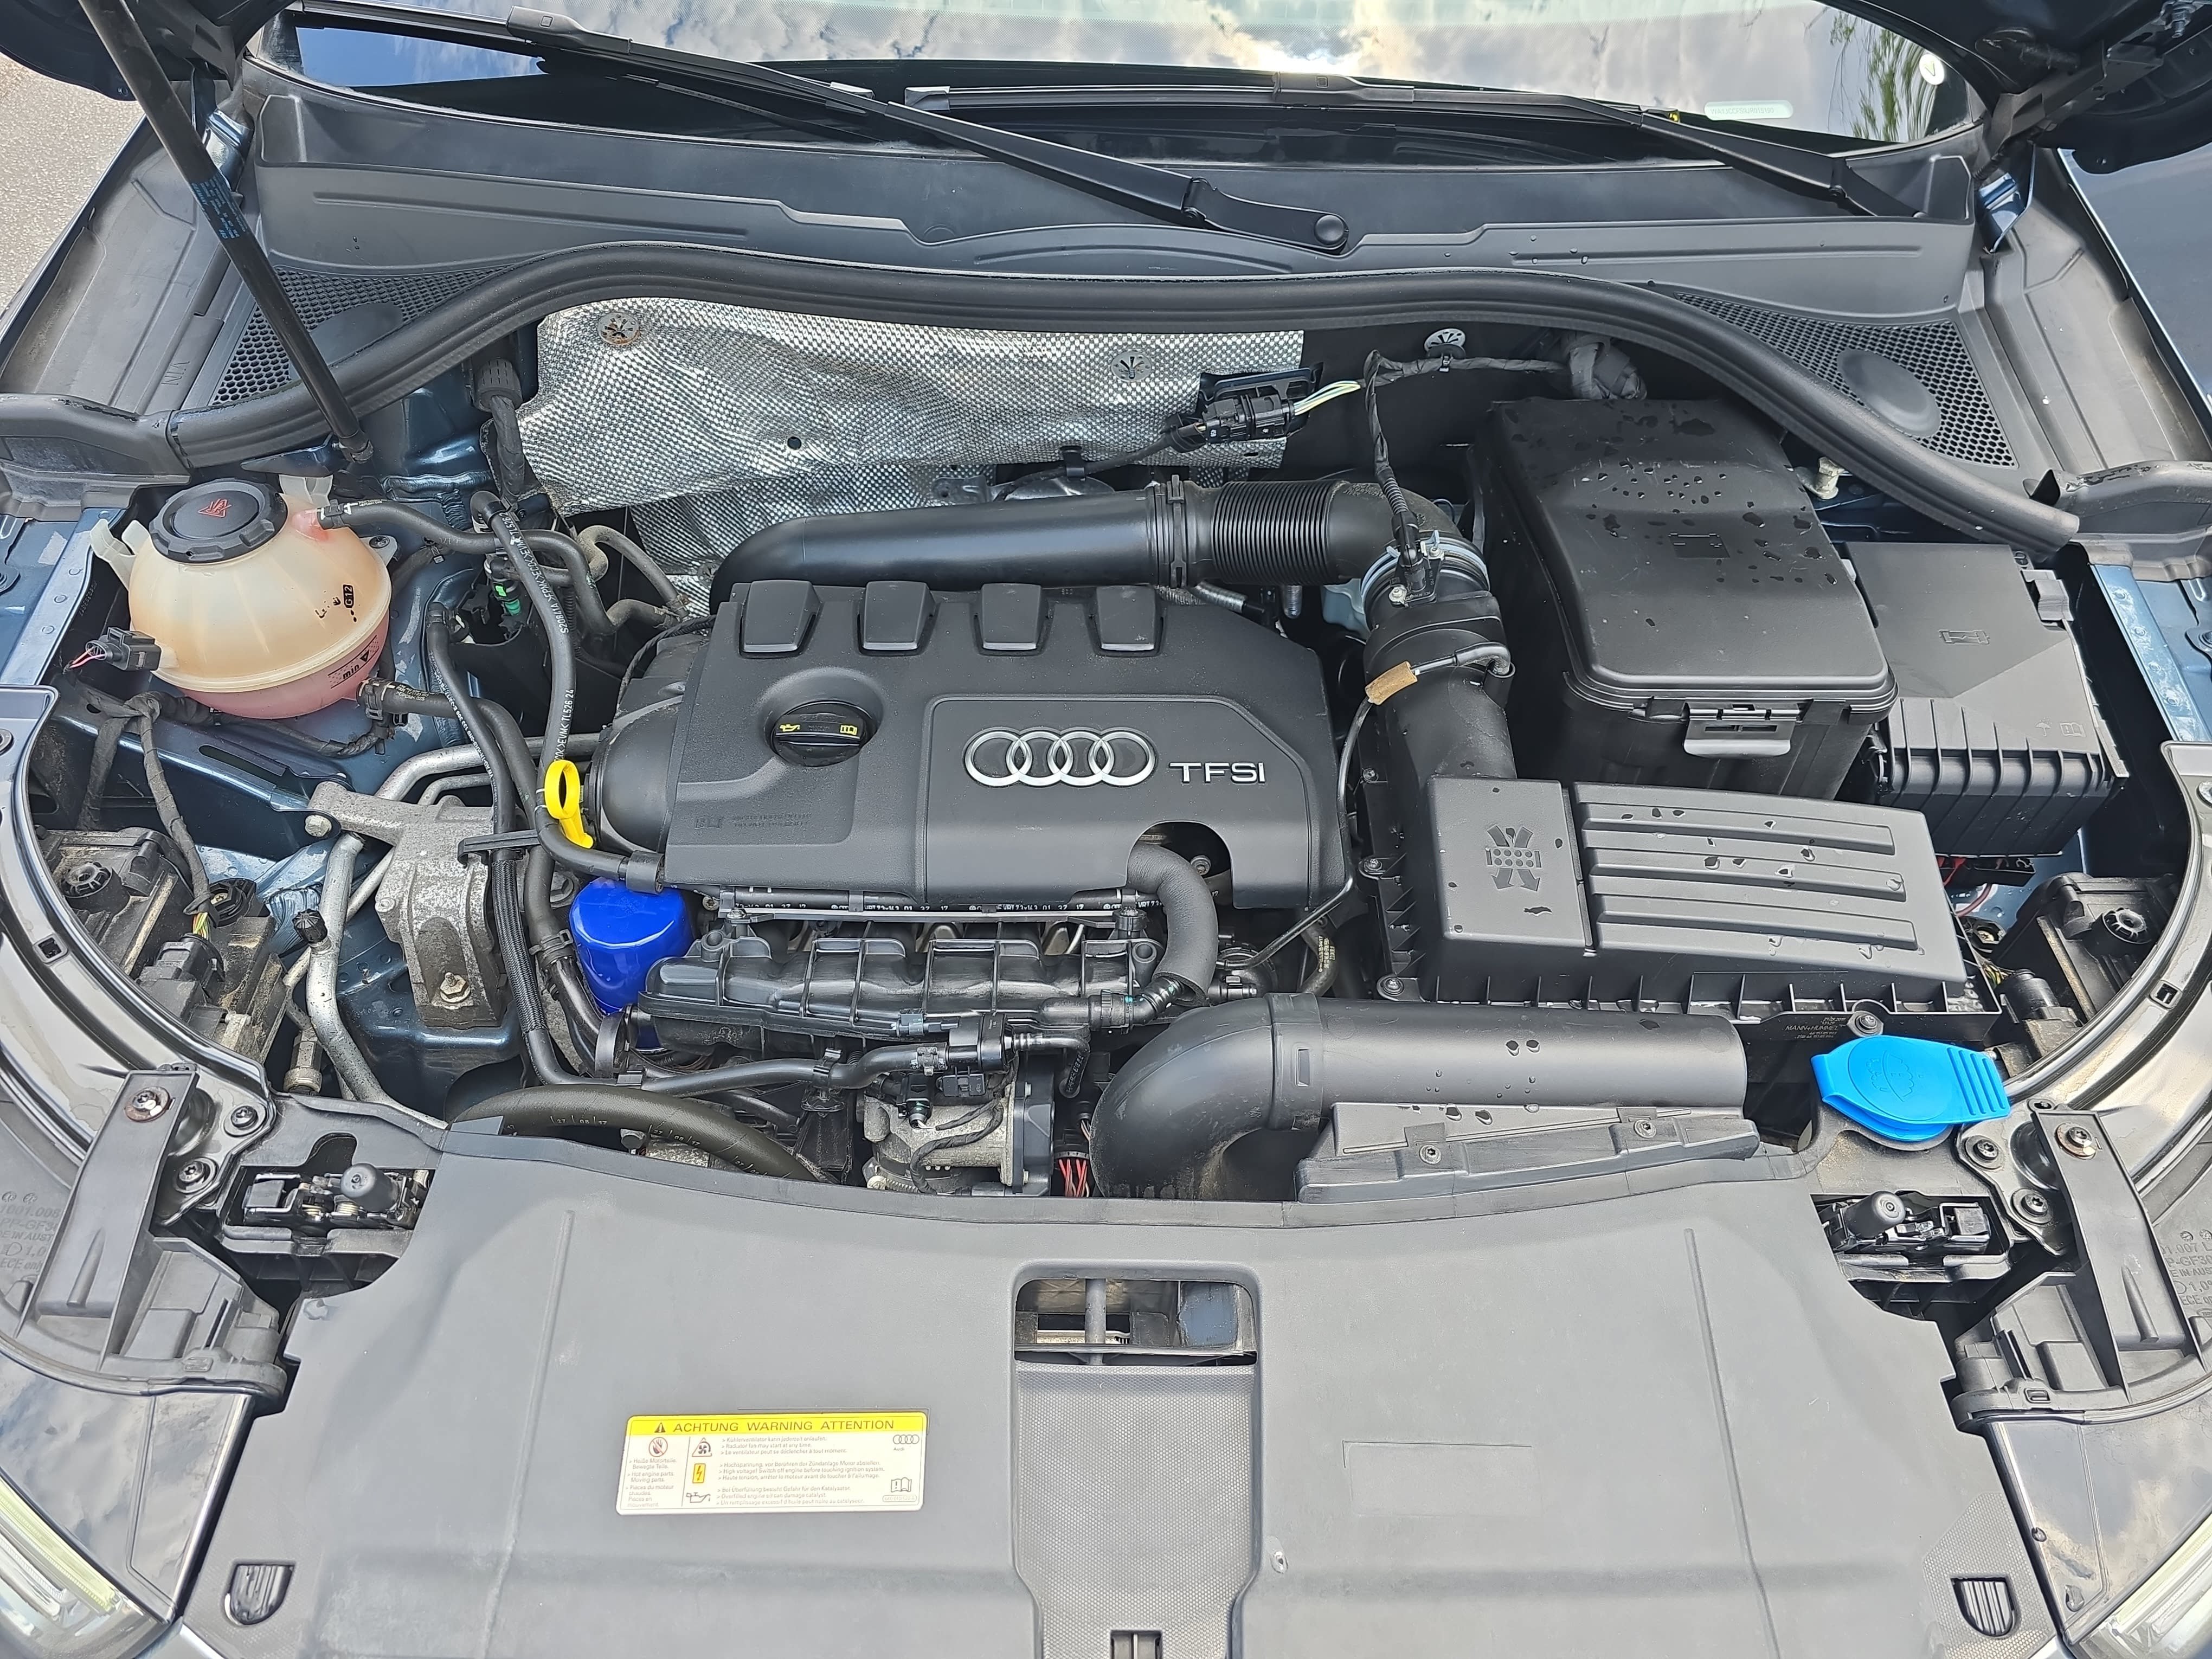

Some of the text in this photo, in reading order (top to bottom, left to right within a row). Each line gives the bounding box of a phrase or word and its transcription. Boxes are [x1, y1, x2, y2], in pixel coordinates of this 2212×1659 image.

[343, 664, 360, 679] min
[565, 689, 574, 698] 24
[561, 700, 573, 722] TL526
[1170, 762, 1266, 785] TFSI
[673, 1420, 895, 1432] ACHTUNG WARNING ATTENTION
